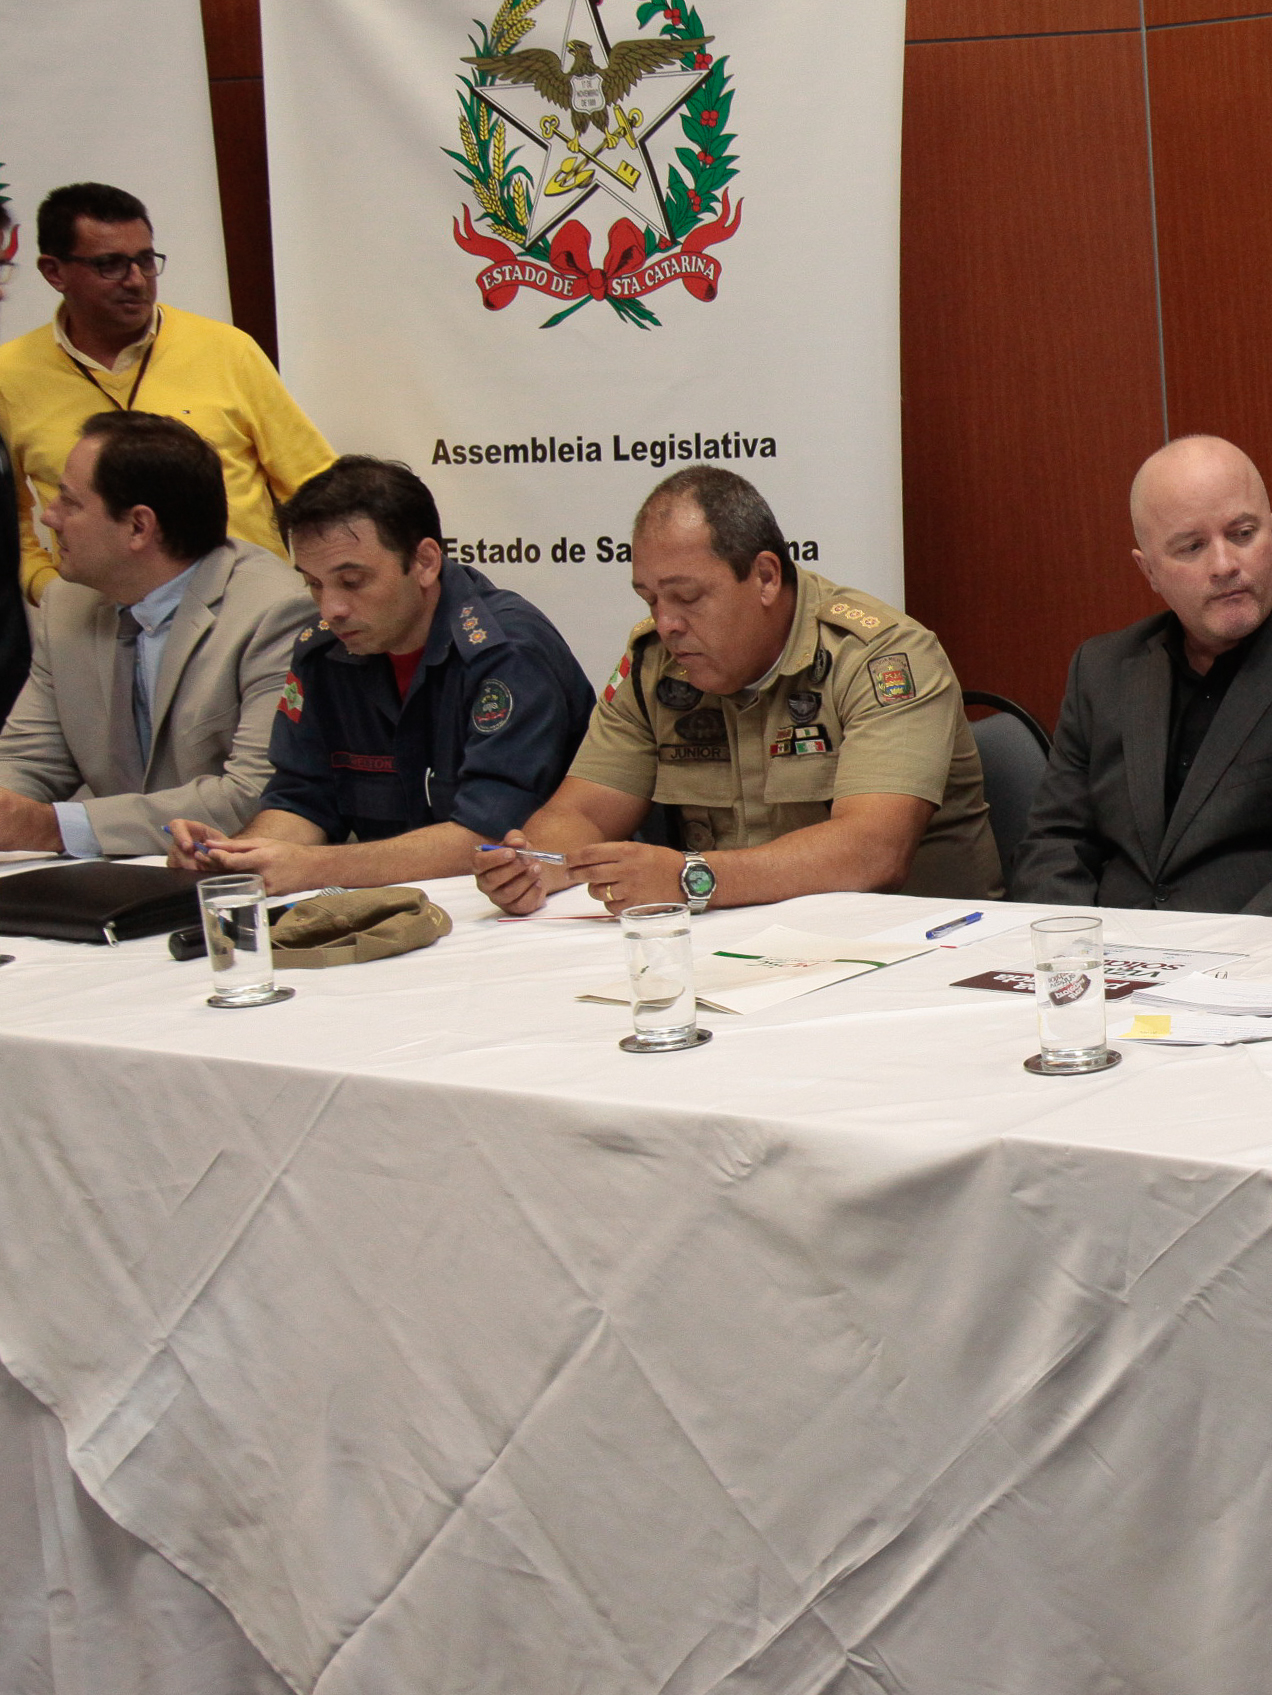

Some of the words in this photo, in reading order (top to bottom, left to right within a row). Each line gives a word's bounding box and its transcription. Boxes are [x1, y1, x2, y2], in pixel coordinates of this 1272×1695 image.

[482, 265, 547, 290] ESTADO
[550, 275, 574, 296] DE
[612, 277, 645, 296] STA.
[645, 255, 715, 280] CATARINA
[432, 436, 602, 465] Assembleia
[613, 431, 777, 468] Legislativa
[442, 537, 541, 564] Estado
[551, 537, 586, 563] de
[670, 747, 720, 759] JUNIOR
